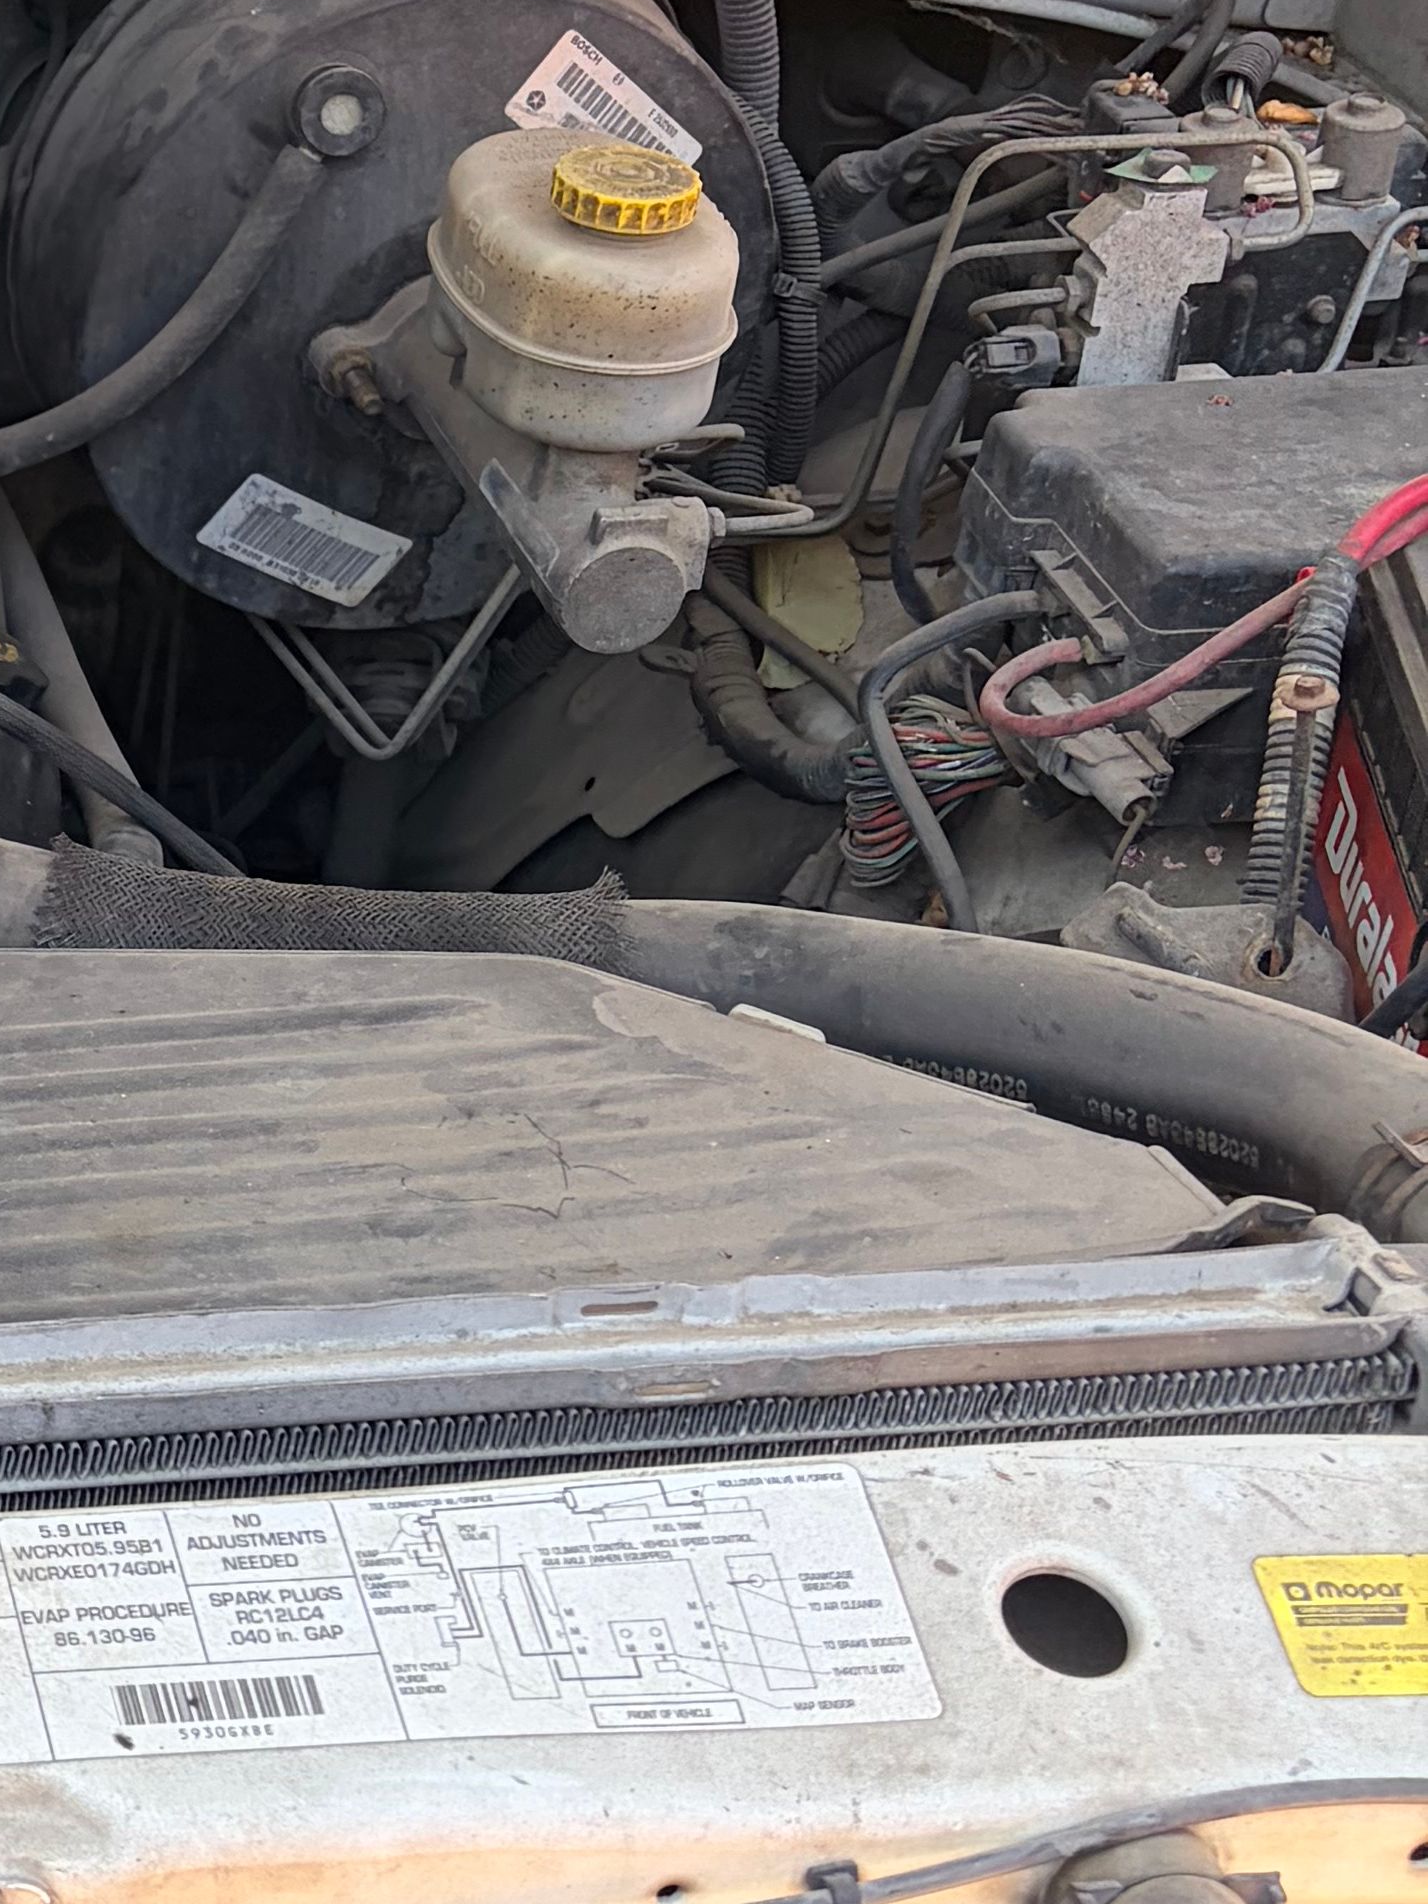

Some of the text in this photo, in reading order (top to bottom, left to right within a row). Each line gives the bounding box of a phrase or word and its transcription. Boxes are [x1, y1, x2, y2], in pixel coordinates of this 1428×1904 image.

[570, 34, 603, 66] BOSCH
[1324, 767, 1406, 1018] Durala
[38, 1520, 127, 1539] 5.9 LITER
[231, 1513, 262, 1528] NO
[184, 1528, 327, 1552] ADJUSTMENTS
[221, 1552, 300, 1571] NEEDED
[208, 1585, 343, 1607] SPARK PLUGS
[19, 1600, 193, 1625] EVAP PROCEDURE
[235, 1605, 325, 1625] RC12LC4
[53, 1626, 156, 1647] 86.130-96
[223, 1624, 346, 1646] .040 in. GAP
